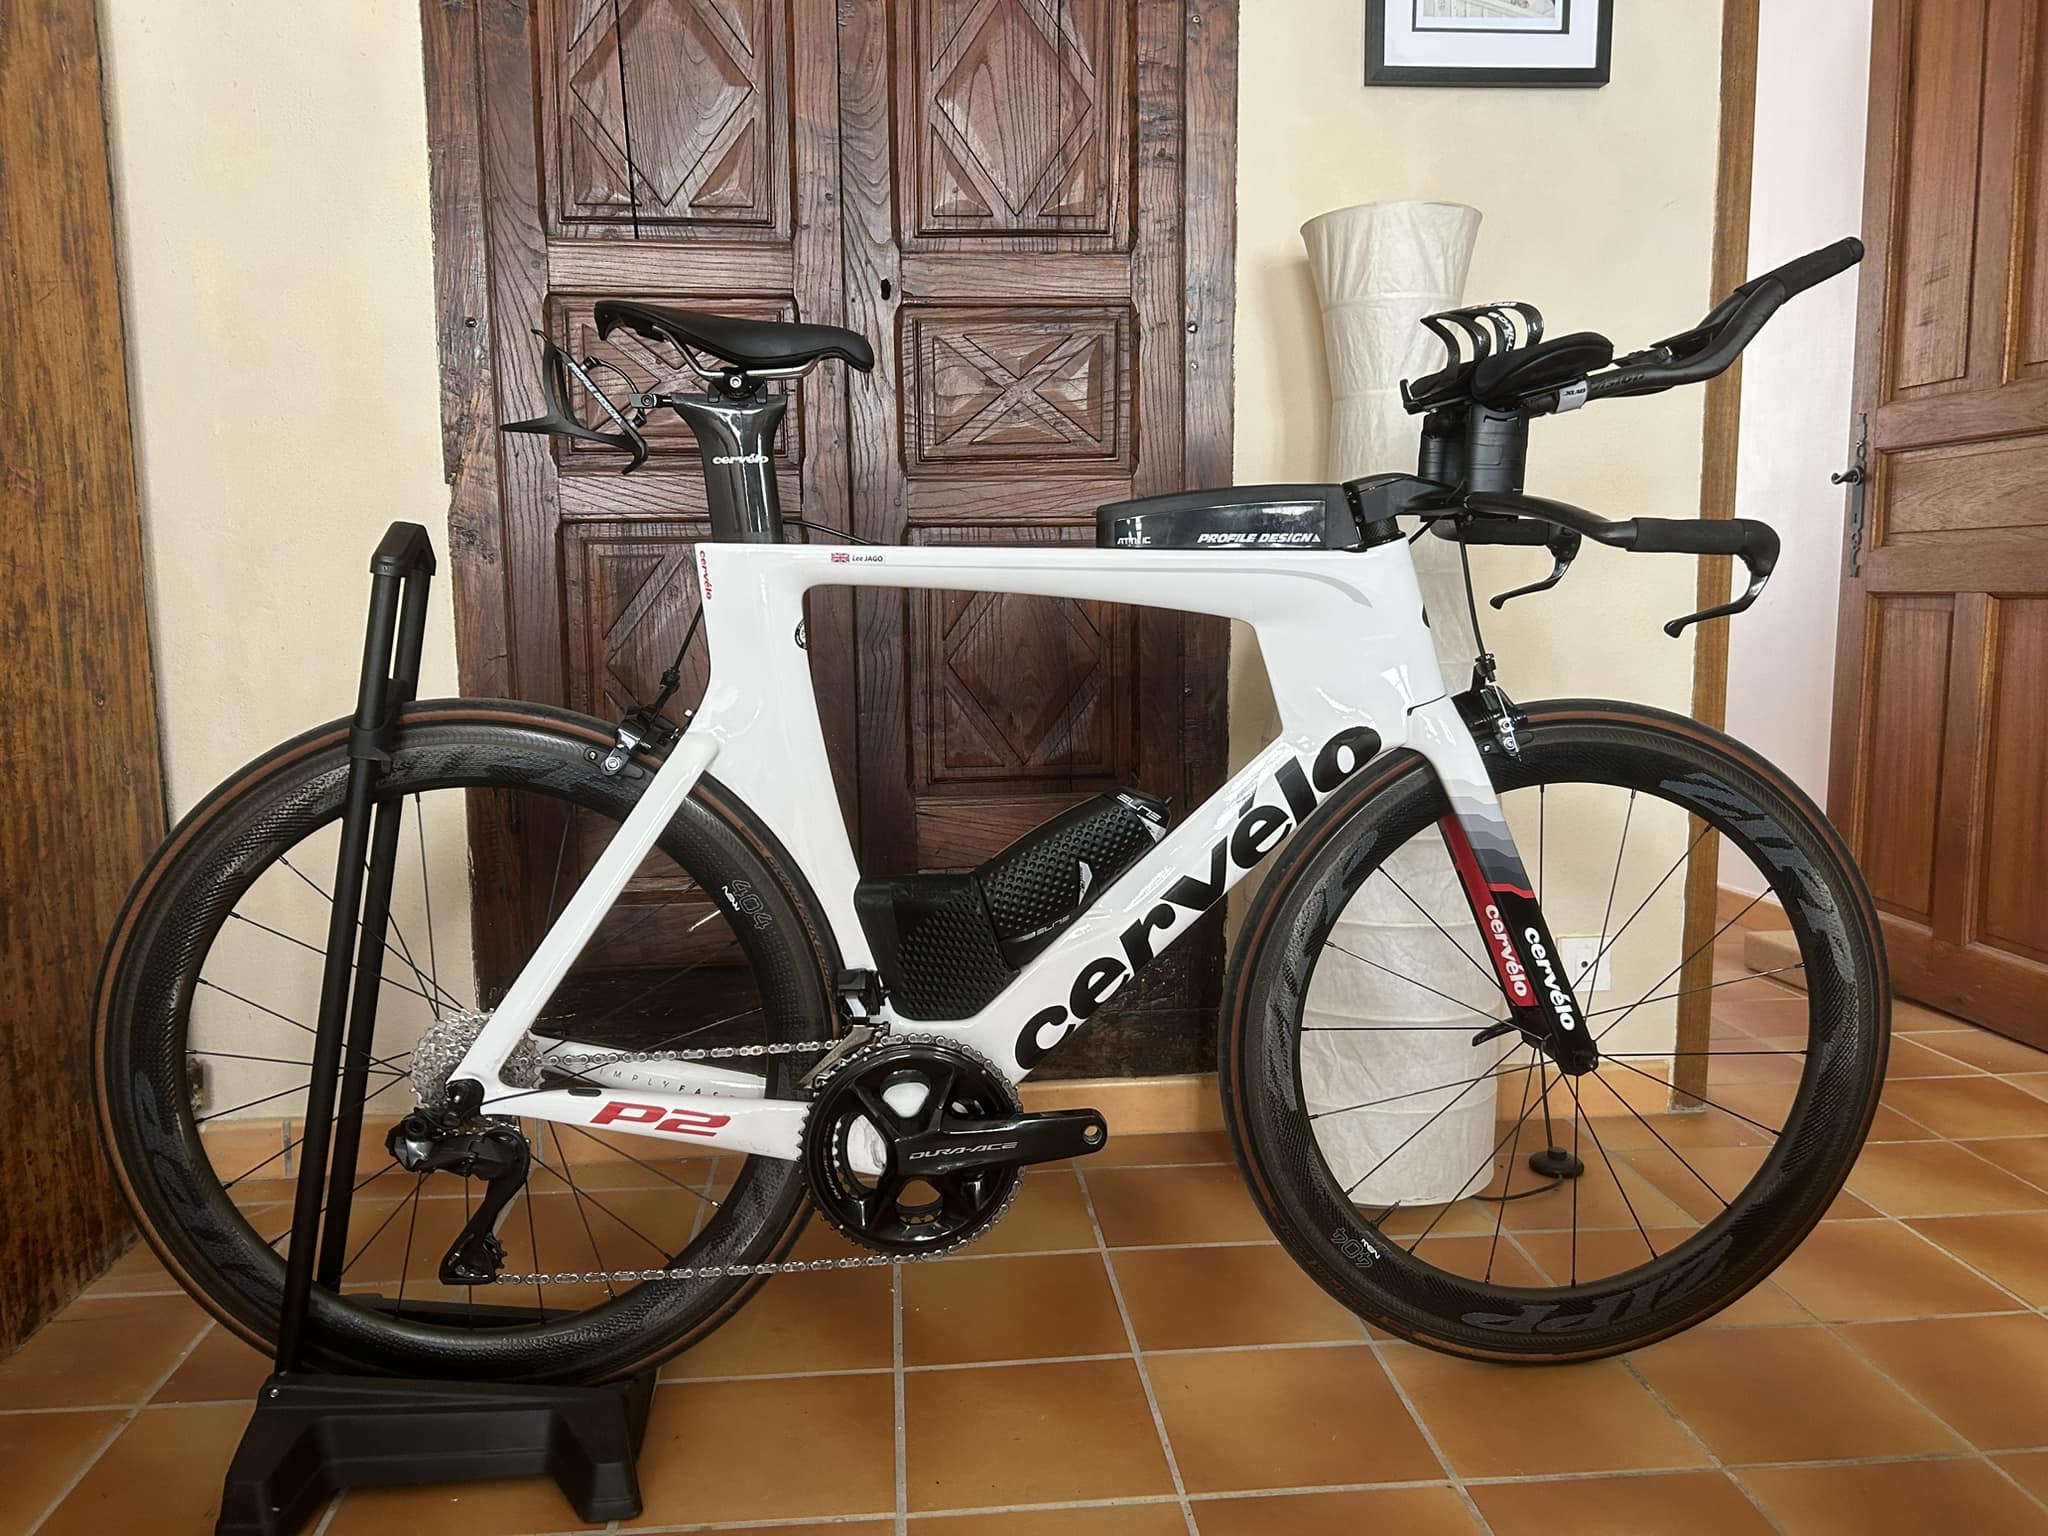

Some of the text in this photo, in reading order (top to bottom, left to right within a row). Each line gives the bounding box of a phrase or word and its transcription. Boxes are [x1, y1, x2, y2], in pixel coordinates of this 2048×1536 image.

[851, 554, 884, 563] Lee JAGO
[1197, 532, 1314, 544] PROFILE DESIGN
[731, 879, 773, 930] 404
[1015, 726, 1382, 1069] cervélo
[1485, 904, 1528, 998] cervélo
[1524, 926, 1576, 1032] cervélo
[590, 1101, 732, 1137] P2
[908, 1141, 1019, 1161] DURA-ACE
[1329, 1226, 1374, 1269] 404
